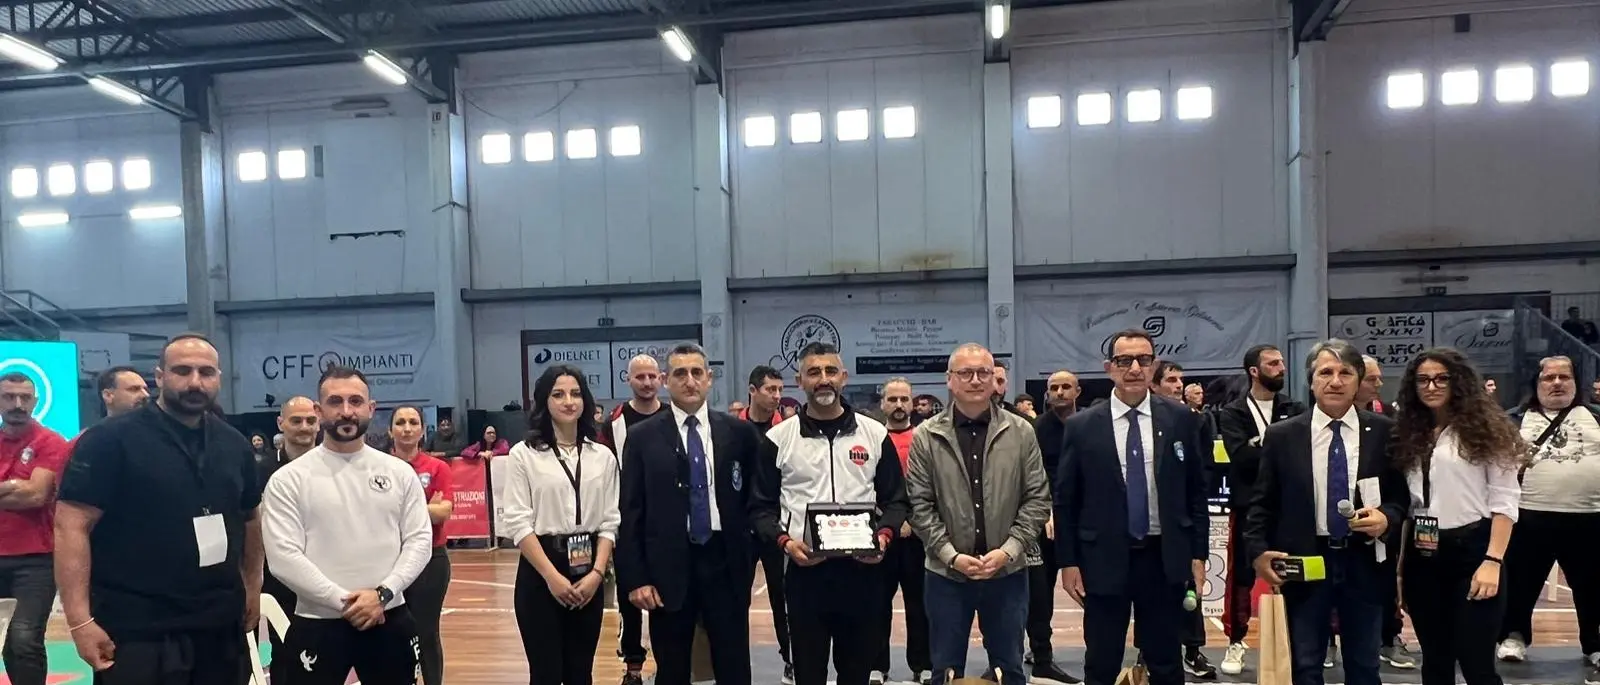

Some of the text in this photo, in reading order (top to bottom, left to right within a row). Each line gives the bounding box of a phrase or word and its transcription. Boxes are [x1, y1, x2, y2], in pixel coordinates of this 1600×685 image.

[553, 350, 601, 361] DIELNET
[262, 353, 413, 380] CFF IMPIANTI
[1416, 518, 1438, 526] STAFF
[568, 535, 590, 544] STAFF
